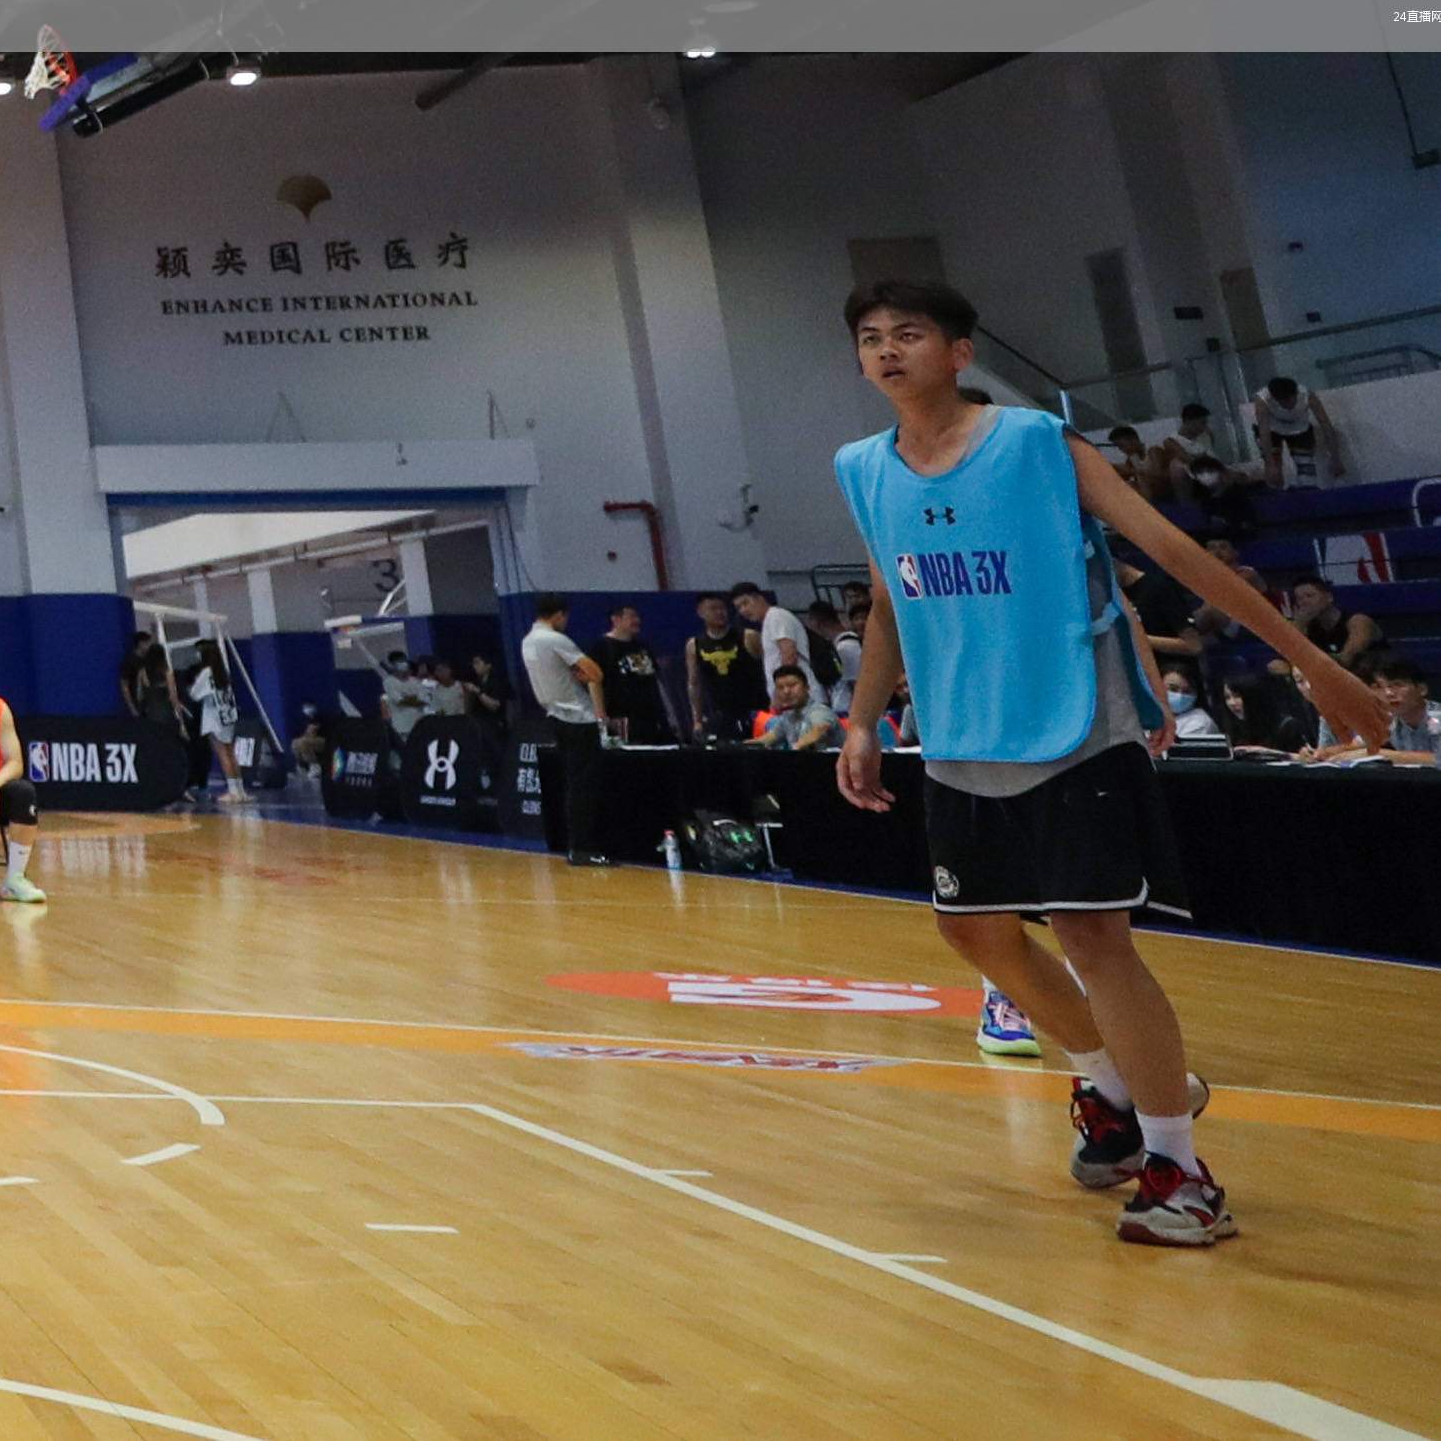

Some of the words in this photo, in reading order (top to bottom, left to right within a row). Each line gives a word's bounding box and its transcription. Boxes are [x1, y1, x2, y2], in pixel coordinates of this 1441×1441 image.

[154, 232, 471, 279] 颖奕国际医疗
[160, 296, 273, 316] ENHANCE
[281, 290, 479, 313] INTERNATIONAL
[223, 329, 332, 346] MEDICAL
[339, 324, 431, 343] CENTER
[918, 551, 974, 597] NBA
[971, 549, 1012, 595] 3X
[51, 742, 102, 782] NBA
[104, 742, 140, 784] 3X
